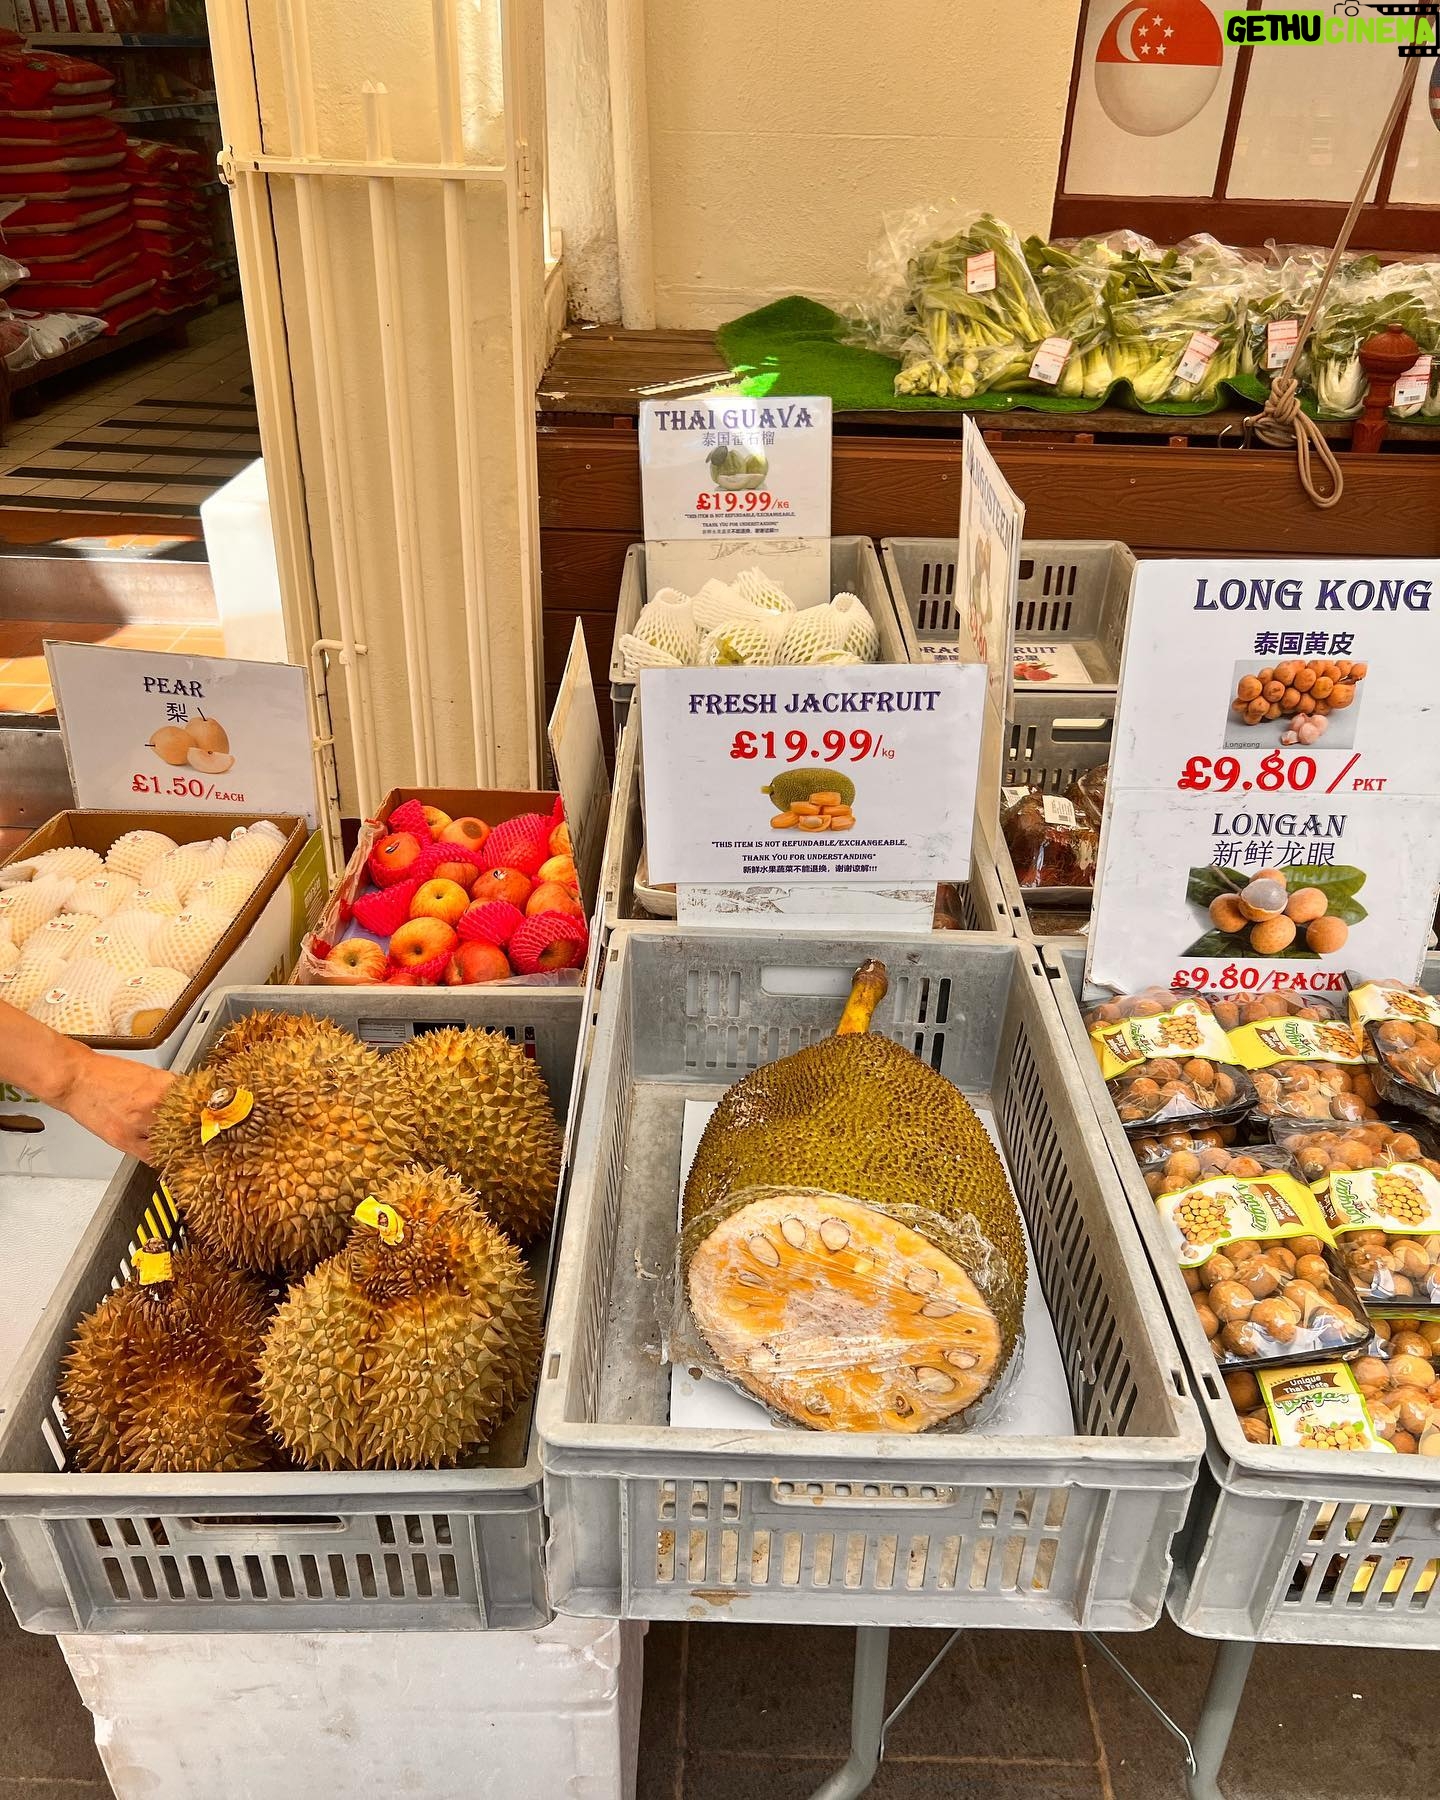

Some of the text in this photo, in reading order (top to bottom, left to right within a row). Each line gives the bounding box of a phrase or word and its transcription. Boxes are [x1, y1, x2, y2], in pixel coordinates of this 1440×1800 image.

[655, 404, 813, 431] THAI GUAVA
[1194, 579, 1433, 611] LONG KONG
[1014, 646, 1057, 654] RUIT
[1254, 632, 1355, 656] 泰国黄皮
[144, 676, 205, 698] PEAR
[166, 702, 188, 723] 梨
[689, 691, 941, 715] FRESH JACKFRUIT
[730, 730, 895, 763] £19.99/kg
[1178, 749, 1317, 793] £9.80
[1212, 813, 1348, 838] LONGAN
[764, 840, 780, 848] NOT
[1209, 840, 1336, 868] 新鲜龙眼
[1171, 964, 1343, 991] £9.80/PACK
[1283, 1382, 1329, 1394] Thai Taste
[1290, 1376, 1322, 1386] Unique
